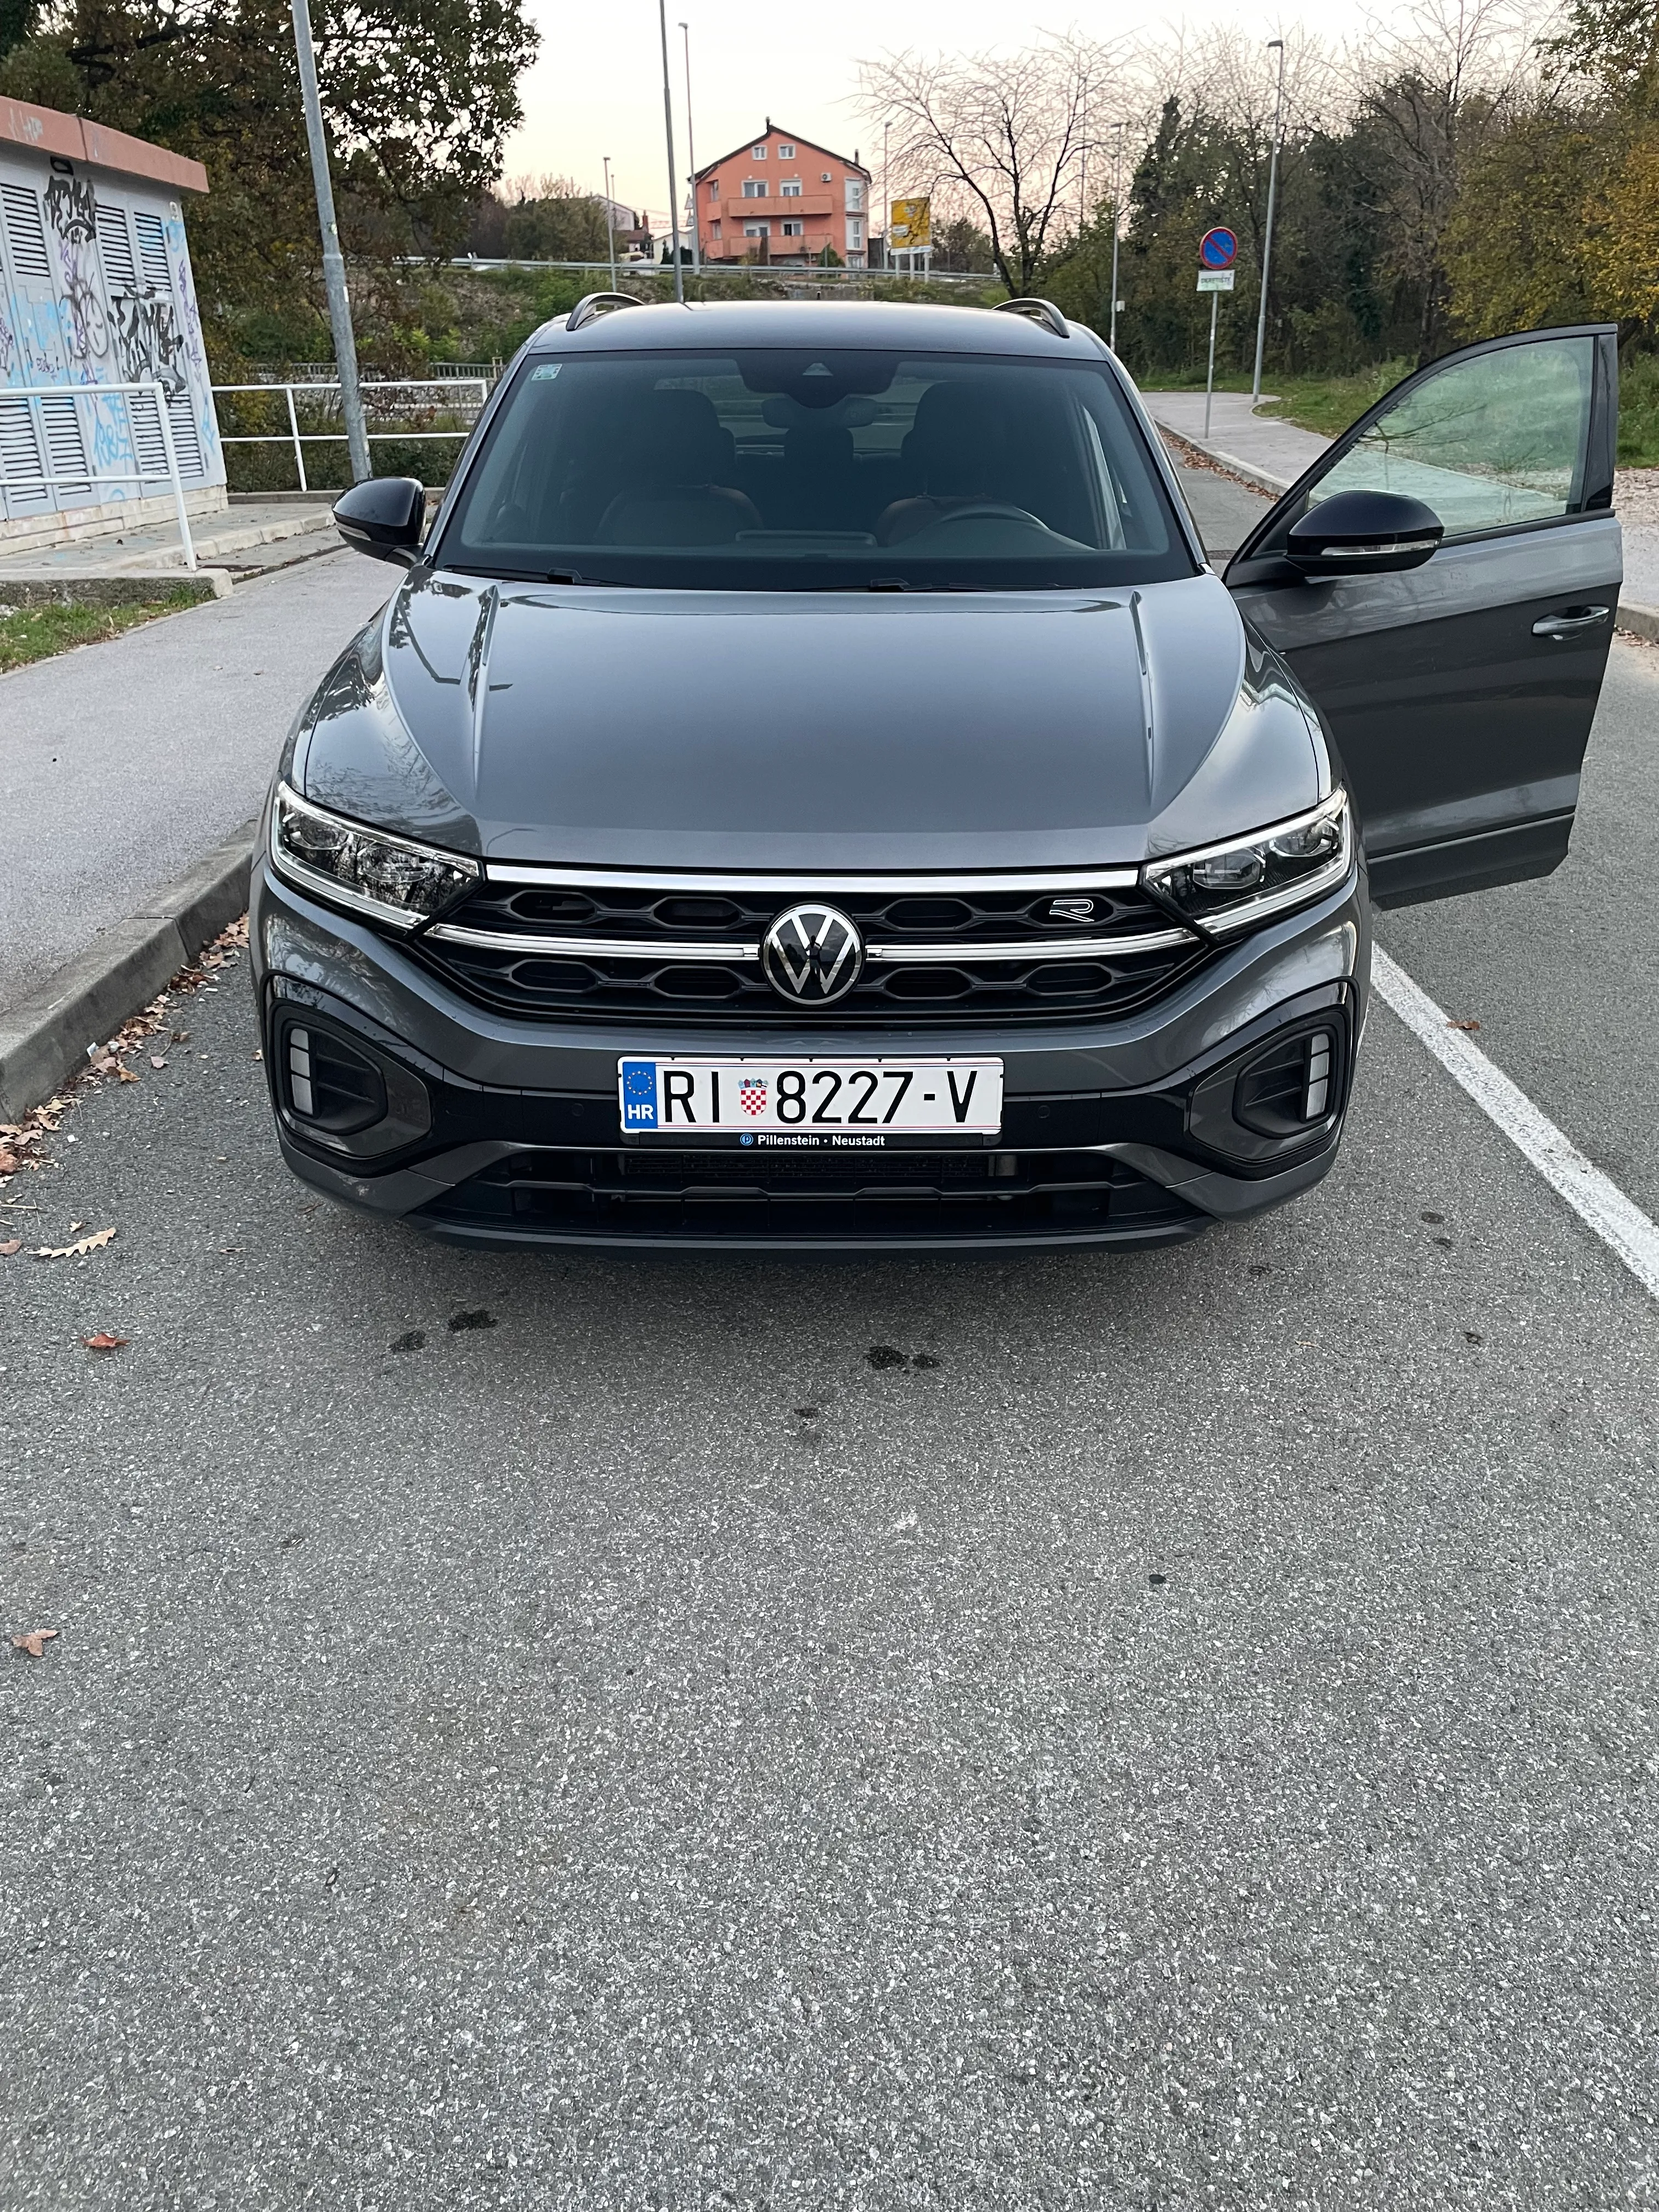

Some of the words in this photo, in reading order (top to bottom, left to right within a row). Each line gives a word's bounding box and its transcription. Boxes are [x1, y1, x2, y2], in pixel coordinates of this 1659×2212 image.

[663, 1070, 719, 1123] RI
[776, 1070, 978, 1124] 8227-V
[628, 1104, 654, 1120] HR
[758, 1135, 820, 1146] Pillenstein
[832, 1135, 885, 1146] Neustadt
